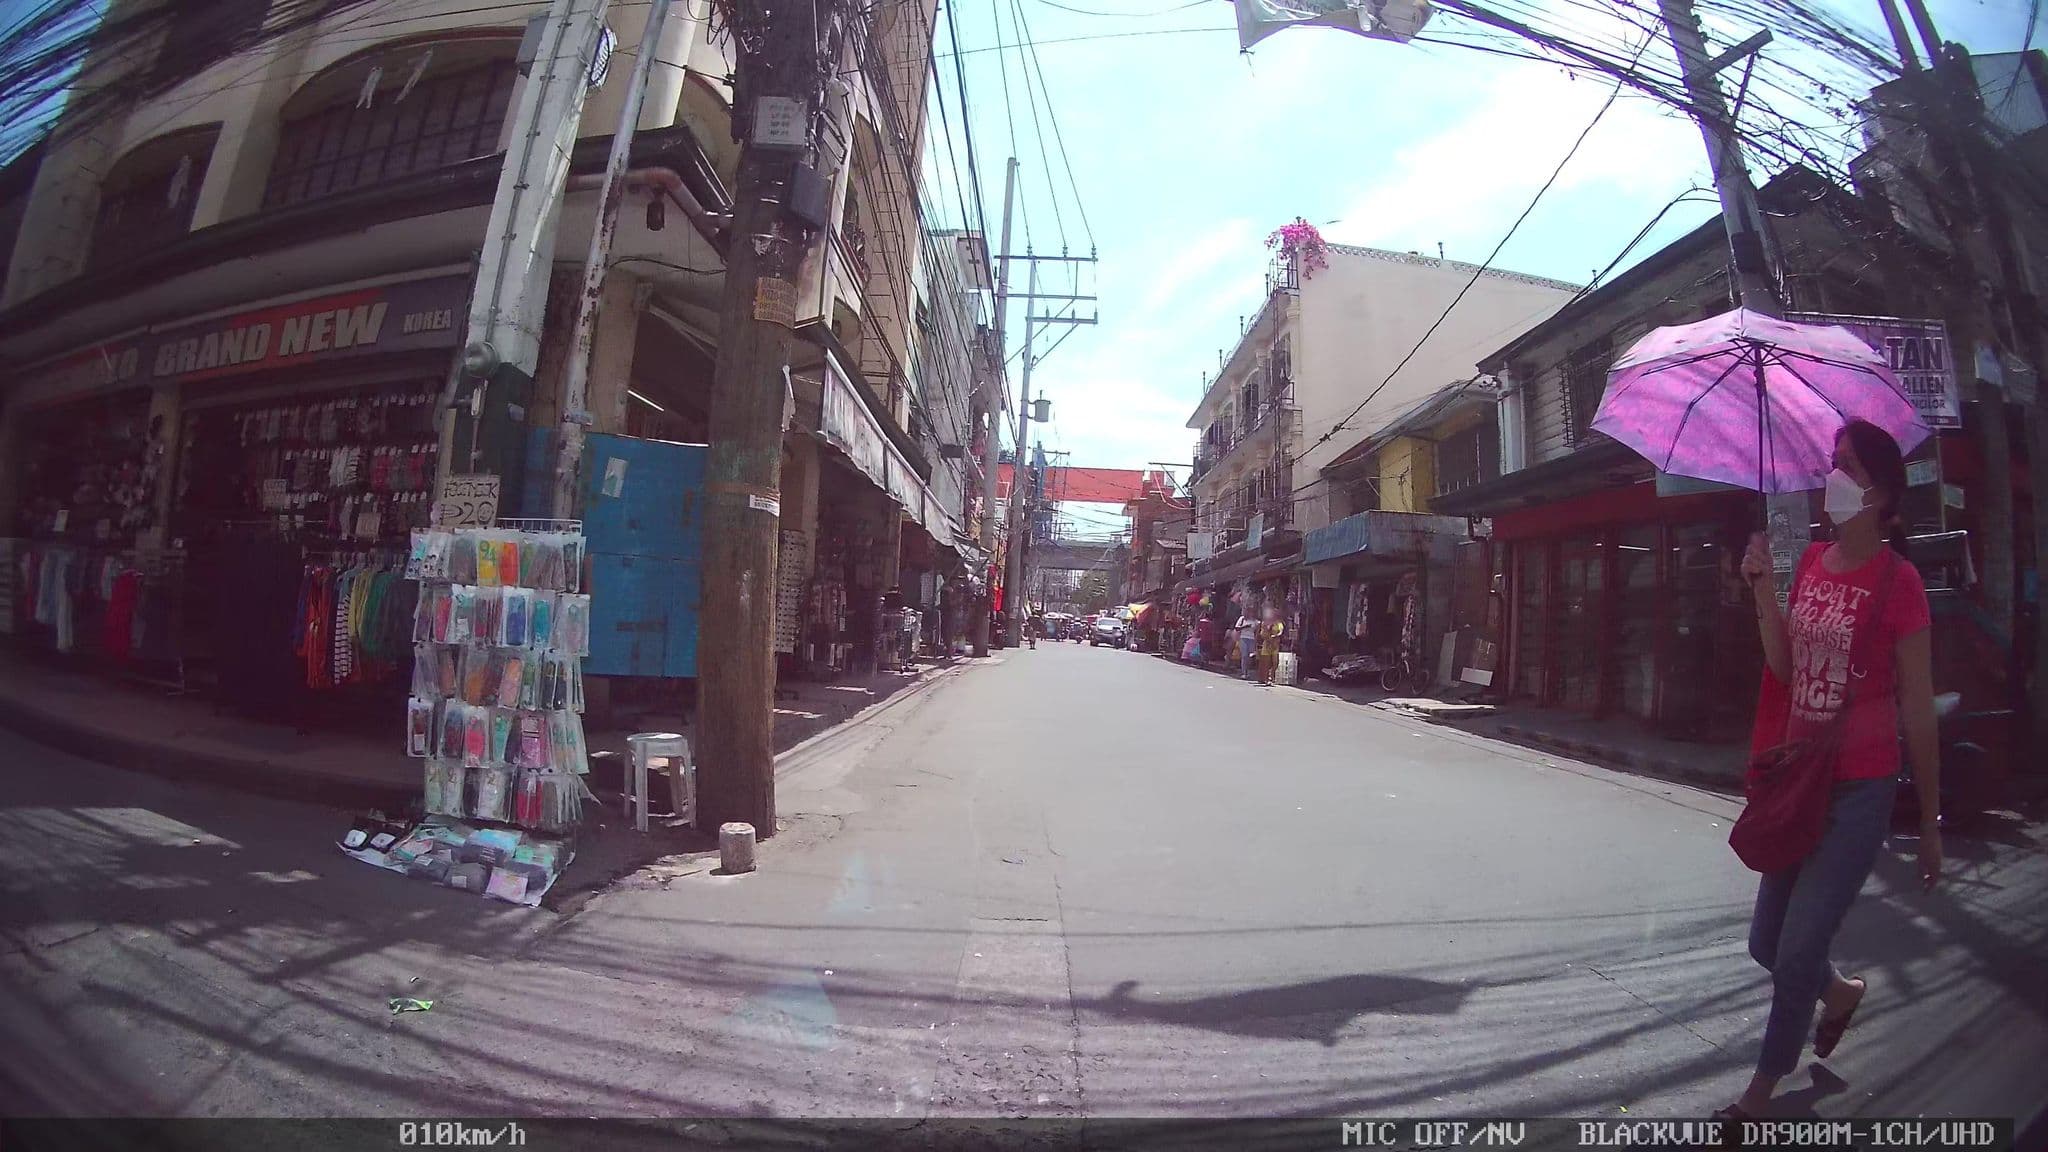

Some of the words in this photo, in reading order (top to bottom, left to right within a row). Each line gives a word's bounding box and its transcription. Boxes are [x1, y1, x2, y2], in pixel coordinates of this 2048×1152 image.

[154, 324, 271, 376] BRAND
[279, 302, 388, 357] NEW
[404, 310, 451, 334] KOREA
[1885, 336, 1943, 371] TAN
[1902, 376, 1945, 395] ALLEN
